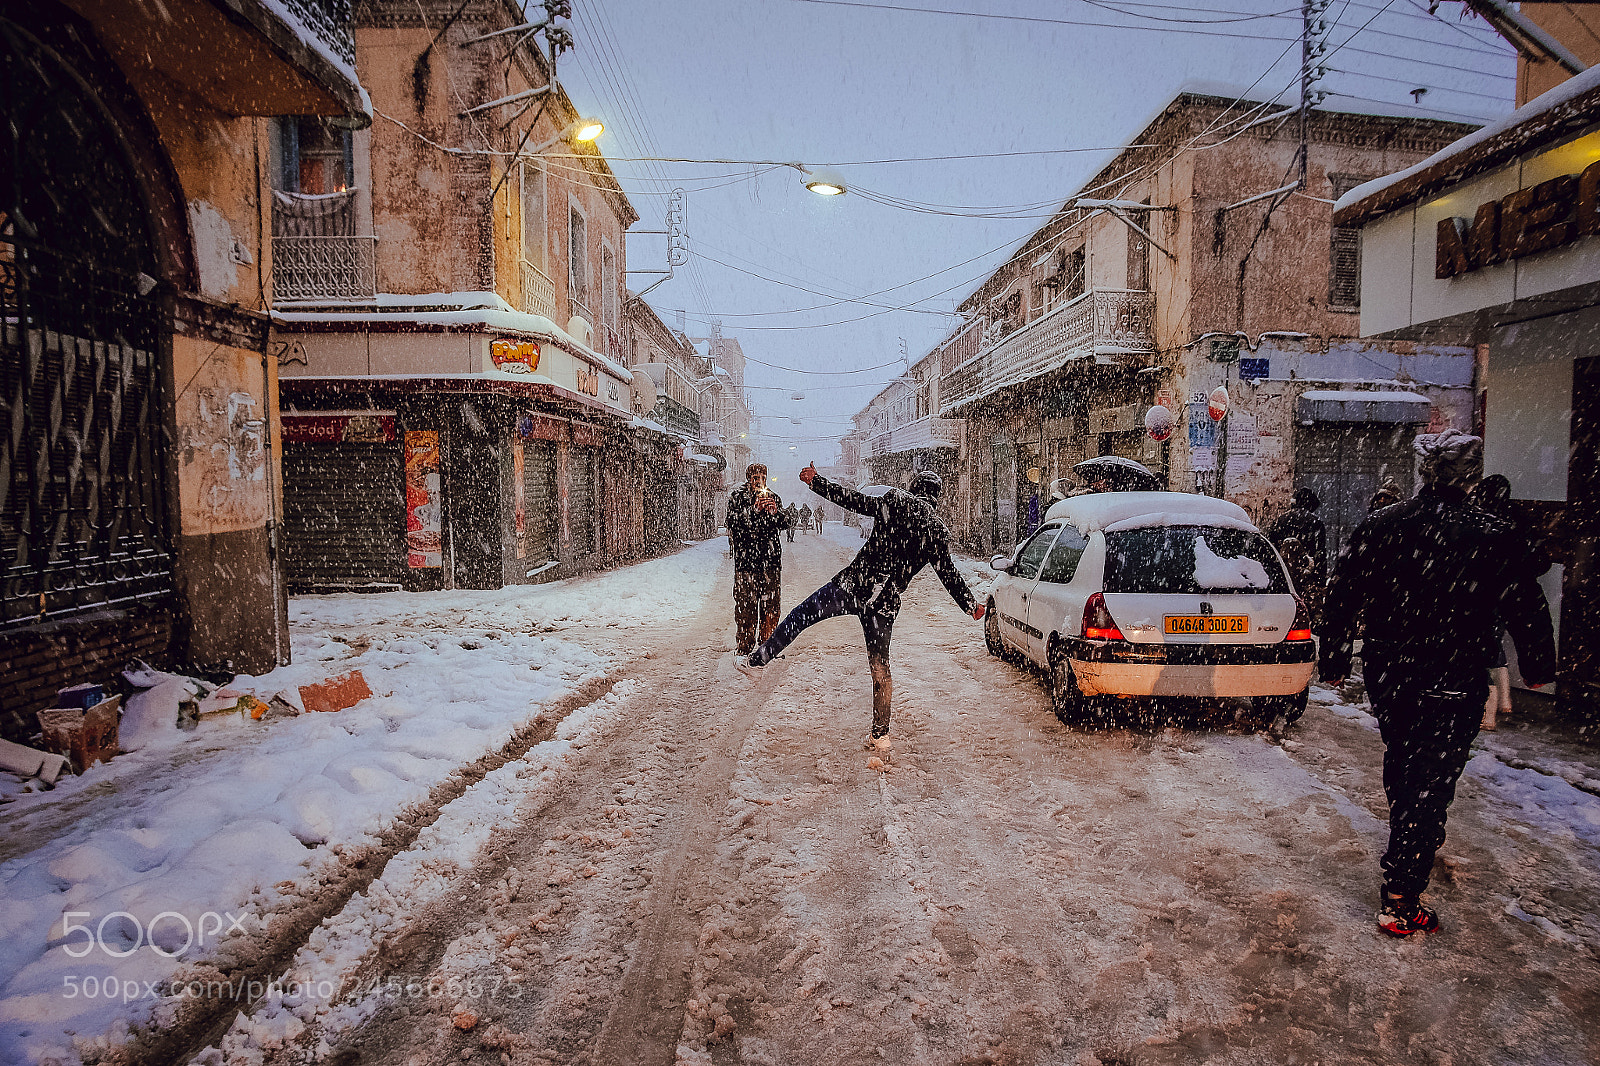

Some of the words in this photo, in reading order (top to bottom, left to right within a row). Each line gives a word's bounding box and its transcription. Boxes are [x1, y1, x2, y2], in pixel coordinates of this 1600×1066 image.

[1171, 618, 1205, 631] 04648
[1208, 618, 1227, 631] 300
[1230, 618, 1243, 631] 26
